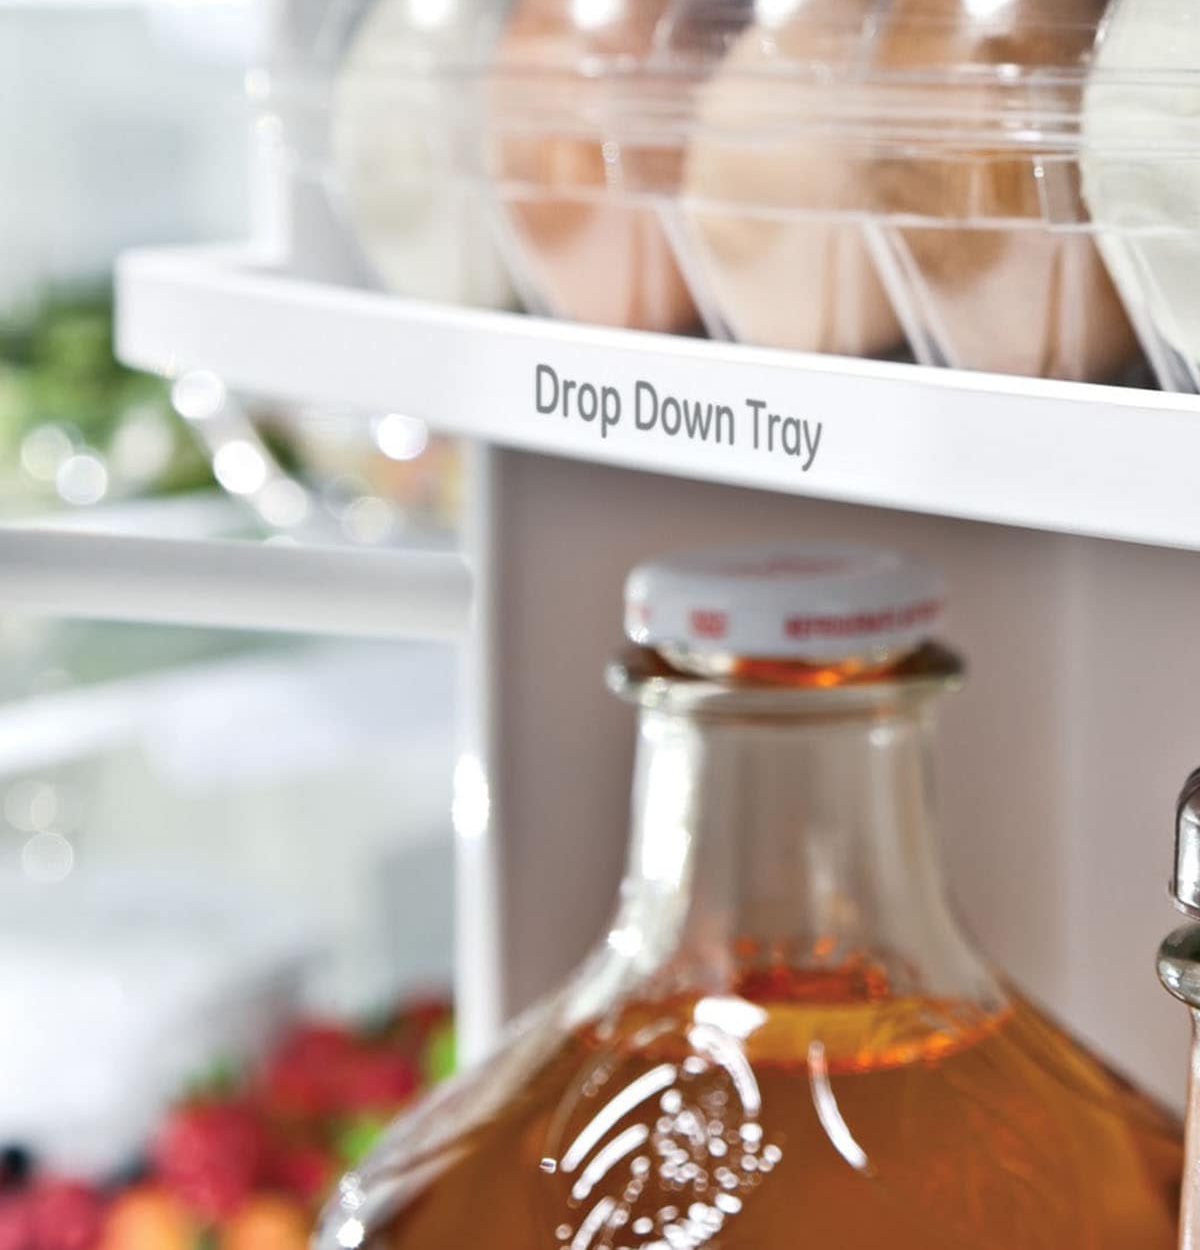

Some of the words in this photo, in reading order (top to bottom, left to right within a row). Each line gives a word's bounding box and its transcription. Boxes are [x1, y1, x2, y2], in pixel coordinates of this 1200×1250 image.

[535, 363, 622, 439] Drop
[634, 379, 736, 446] Down
[745, 398, 823, 473] Tray
